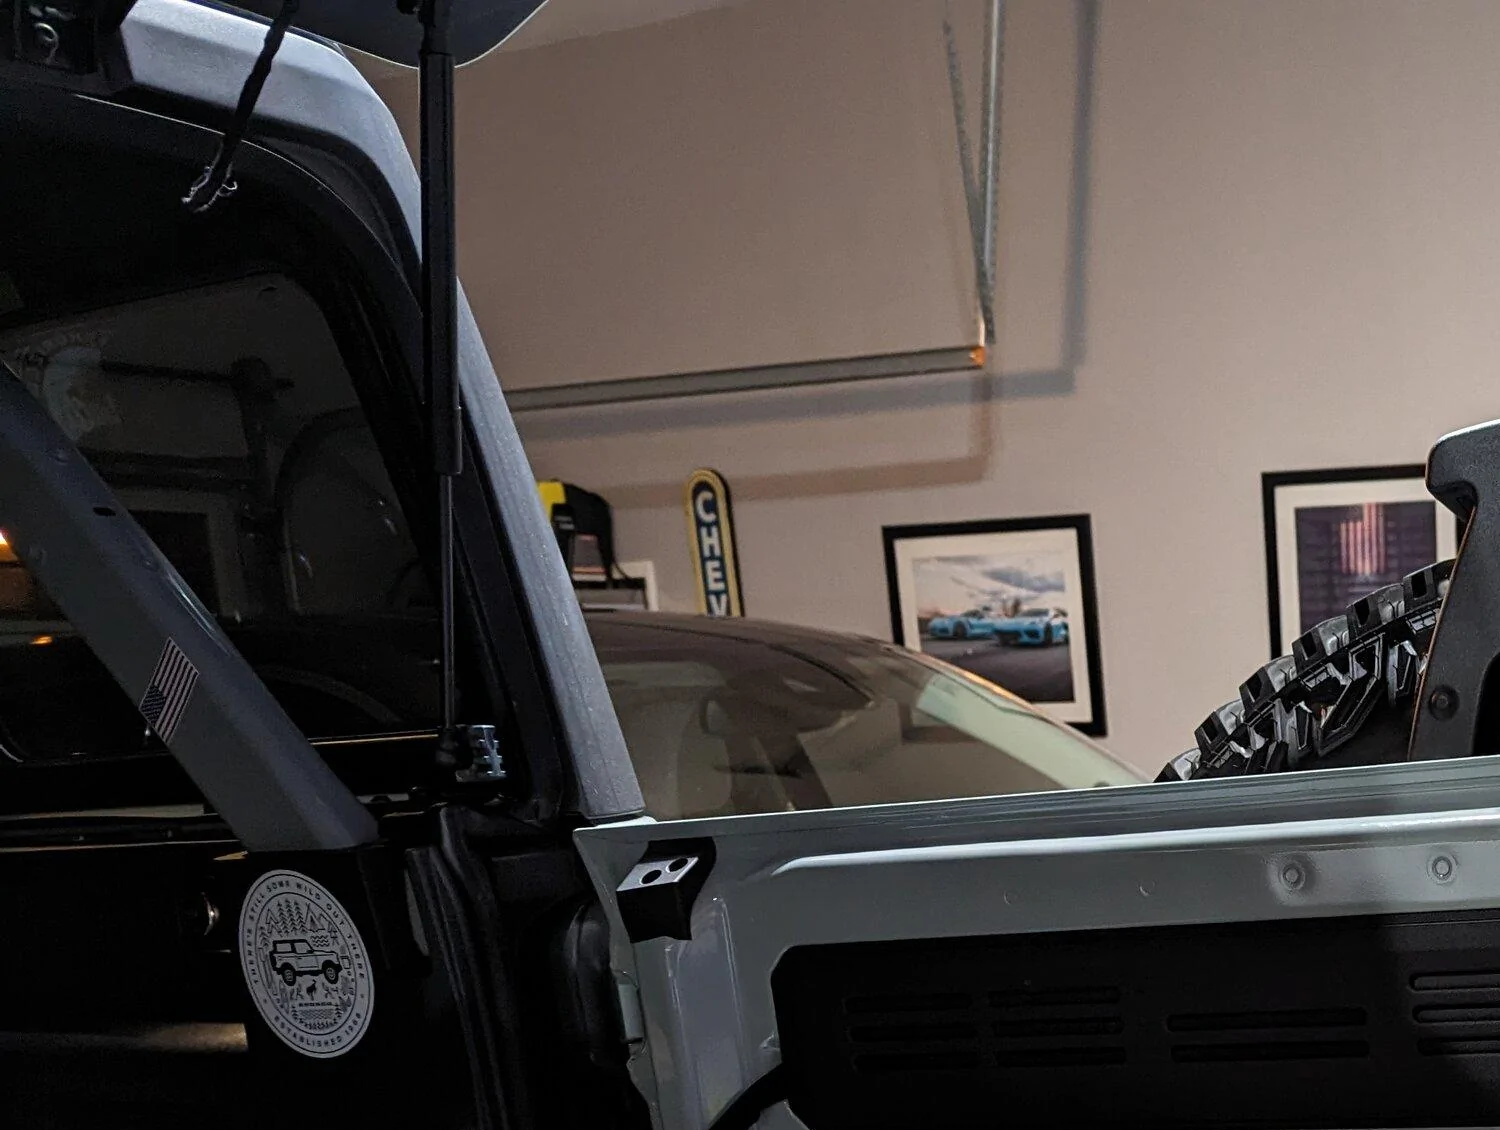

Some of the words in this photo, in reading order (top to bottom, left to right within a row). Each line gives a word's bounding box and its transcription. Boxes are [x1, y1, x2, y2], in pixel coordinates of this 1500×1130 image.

[266, 880, 291, 892] SOME
[296, 881, 321, 900] WILD
[326, 903, 345, 926] OUT
[274, 1015, 342, 1047] ESTABLISHED
